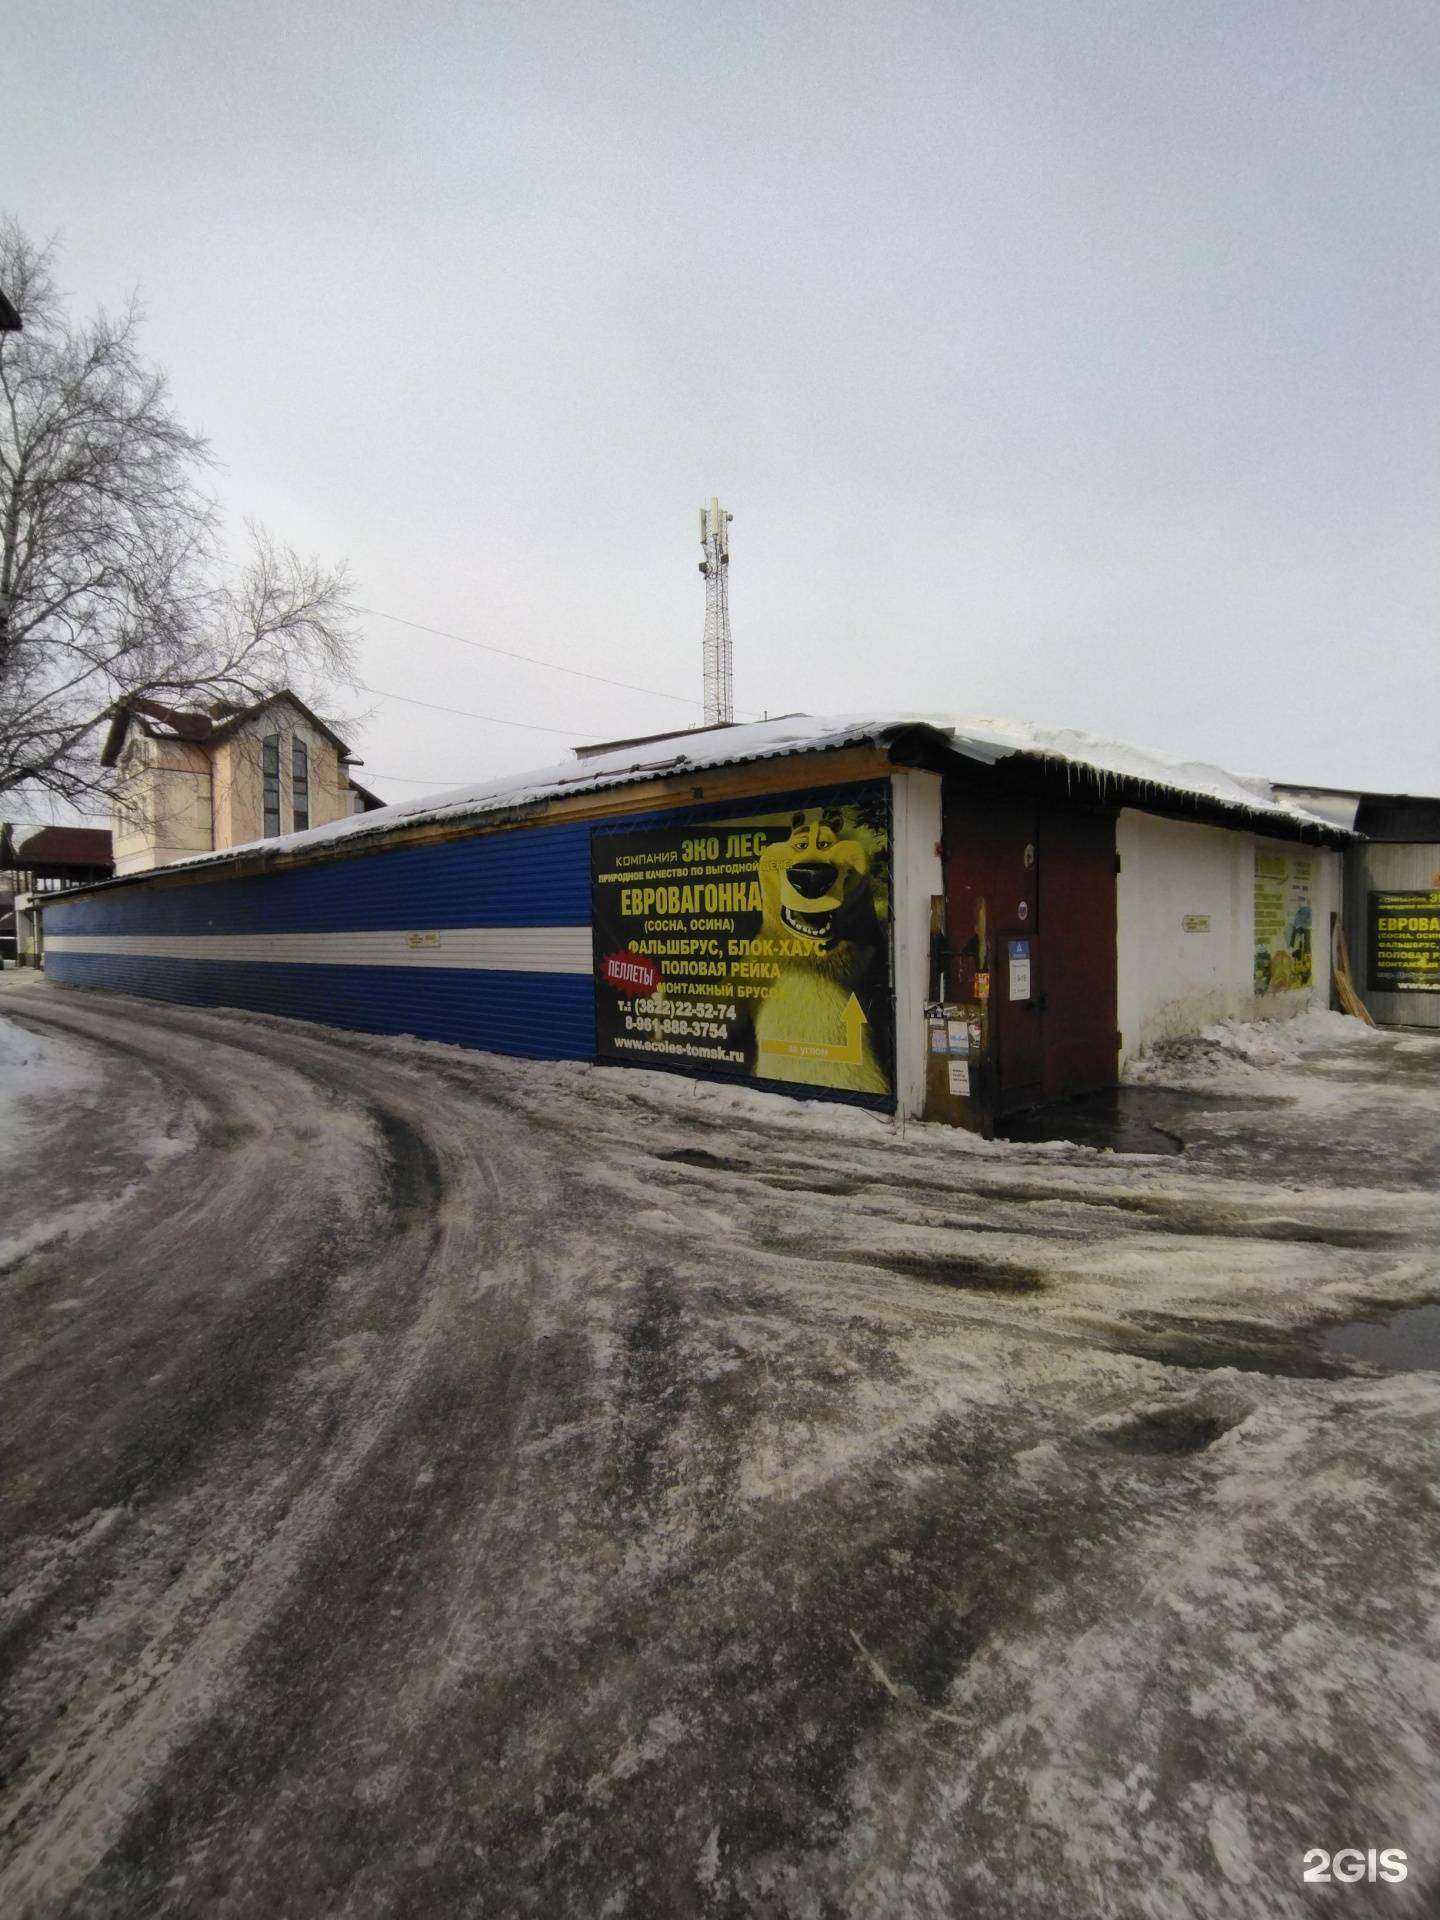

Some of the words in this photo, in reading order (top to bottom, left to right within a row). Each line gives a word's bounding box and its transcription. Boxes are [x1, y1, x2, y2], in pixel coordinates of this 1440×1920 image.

[615, 851, 678, 867] КОМПАНИЯ
[681, 837, 720, 863] ЭКО
[725, 832, 768, 859] ЛЕС
[598, 871, 645, 883] ПРИРОДНОЕ
[645, 867, 689, 880] КАЧЕСТВО
[690, 866, 704, 876] ПО
[705, 861, 760, 875] ВЫГОДНОЙ
[621, 881, 763, 916] ЕВРОВАГОНКА
[644, 919, 688, 934] (СОСНА,
[690, 918, 735, 933] ОСИНА)
[628, 939, 724, 959] ФАЛЬШБРУС,
[728, 939, 827, 957] БЛОК-ХАУС
[607, 959, 654, 986] ПЕЛЛЕТЫ
[661, 960, 726, 977] ПОЛОВАЯ
[731, 960, 781, 978] РЕЙКА
[656, 981, 734, 997] МОНТАЖНЫЙ
[614, 1037, 745, 1063] www.ecoles-tomsk.ru
